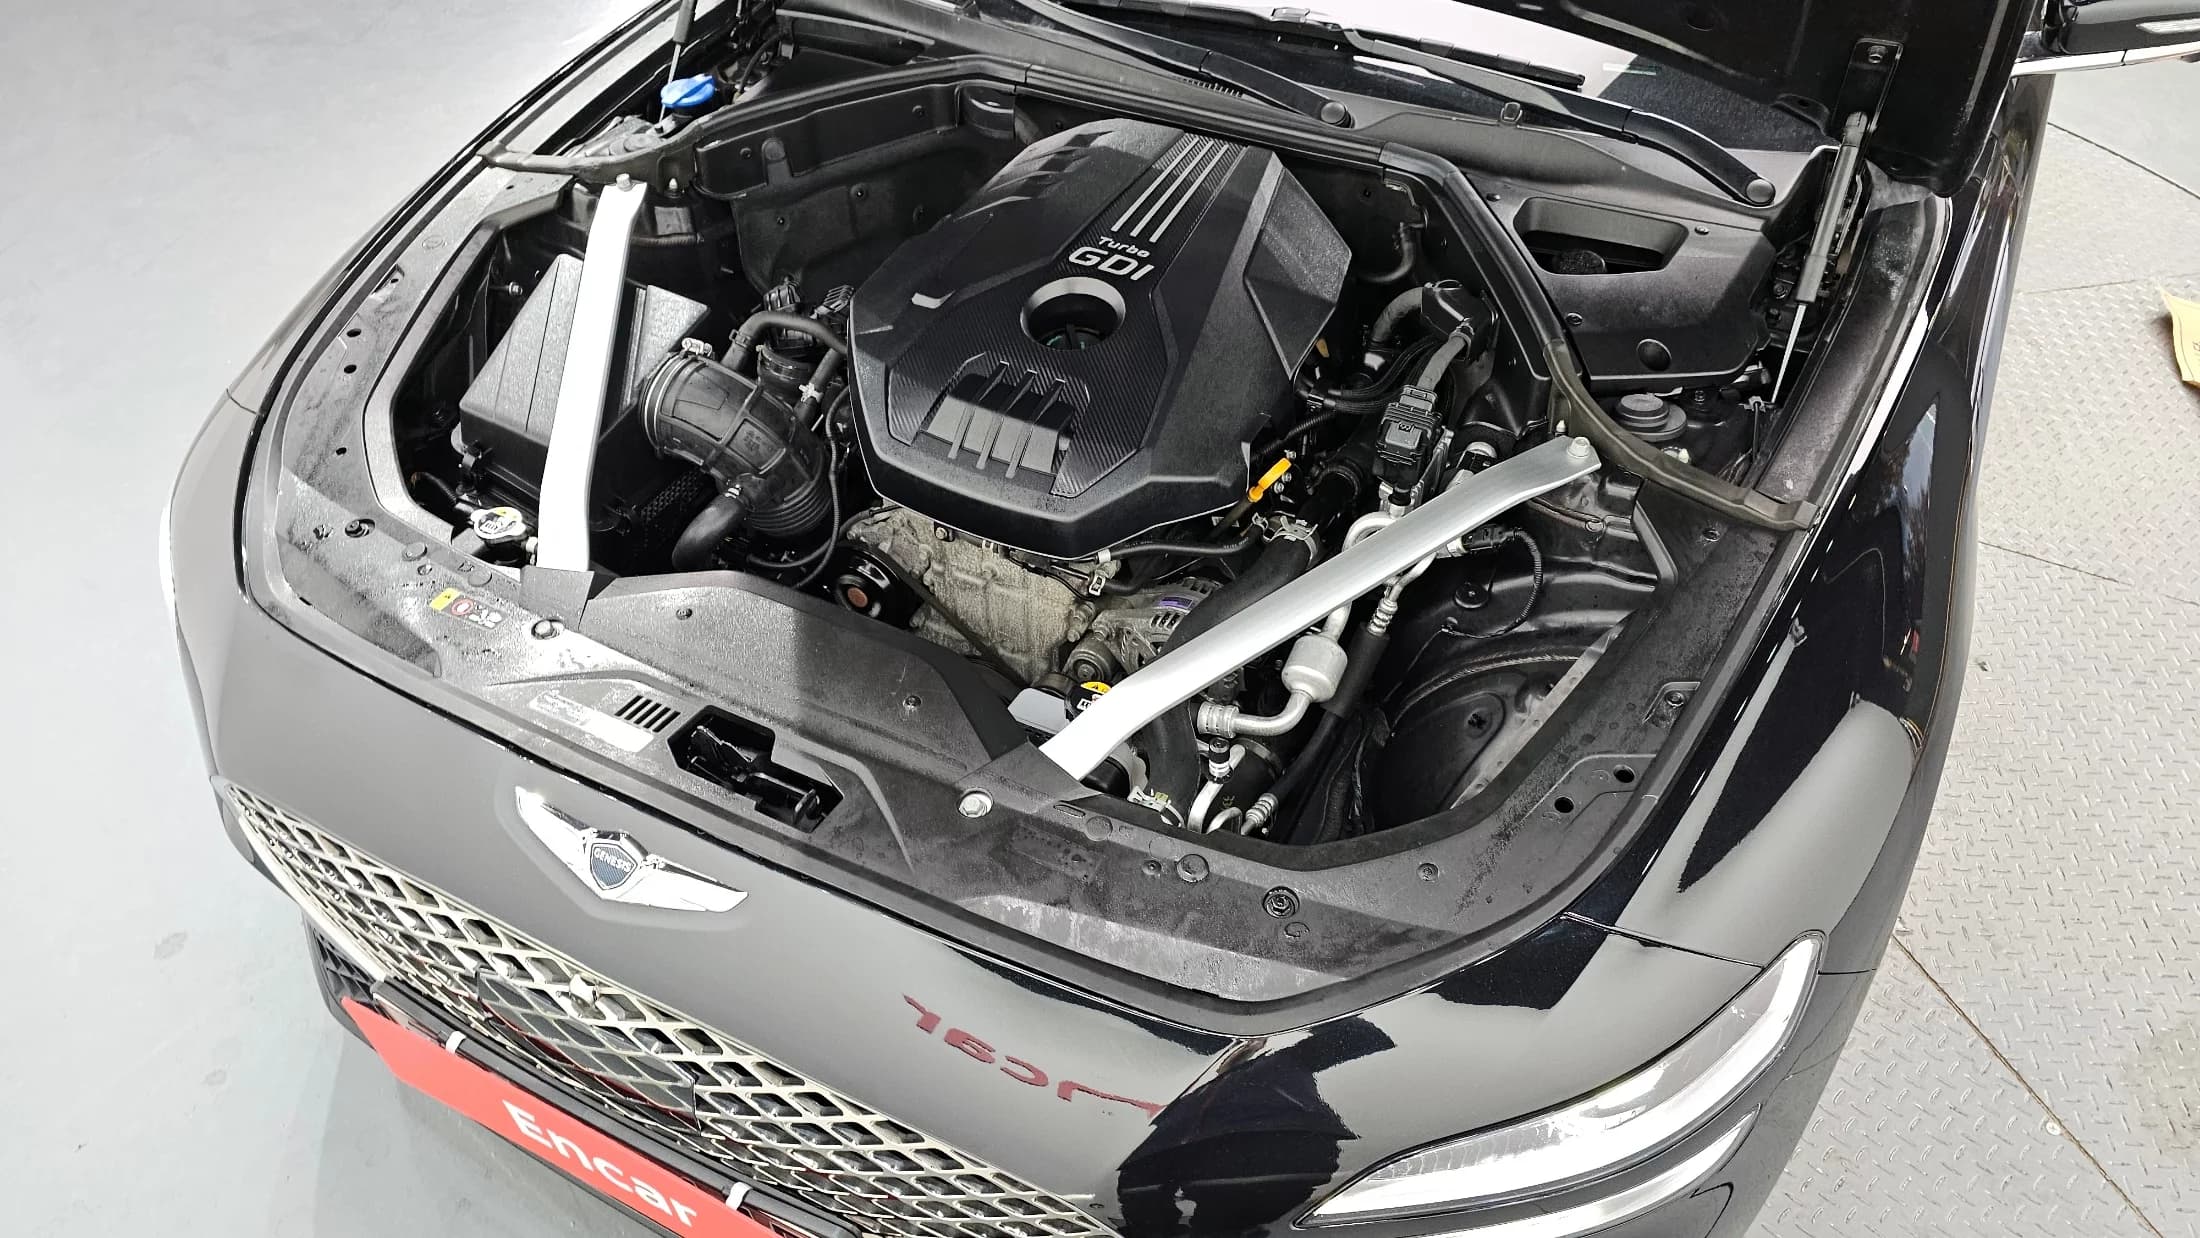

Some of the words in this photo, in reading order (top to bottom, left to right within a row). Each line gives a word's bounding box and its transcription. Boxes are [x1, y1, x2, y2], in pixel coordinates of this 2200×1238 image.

[1098, 236, 1151, 258] Turbo
[1068, 246, 1155, 281] GDI
[594, 847, 634, 873] GENESIS
[502, 1099, 697, 1227] Encar
